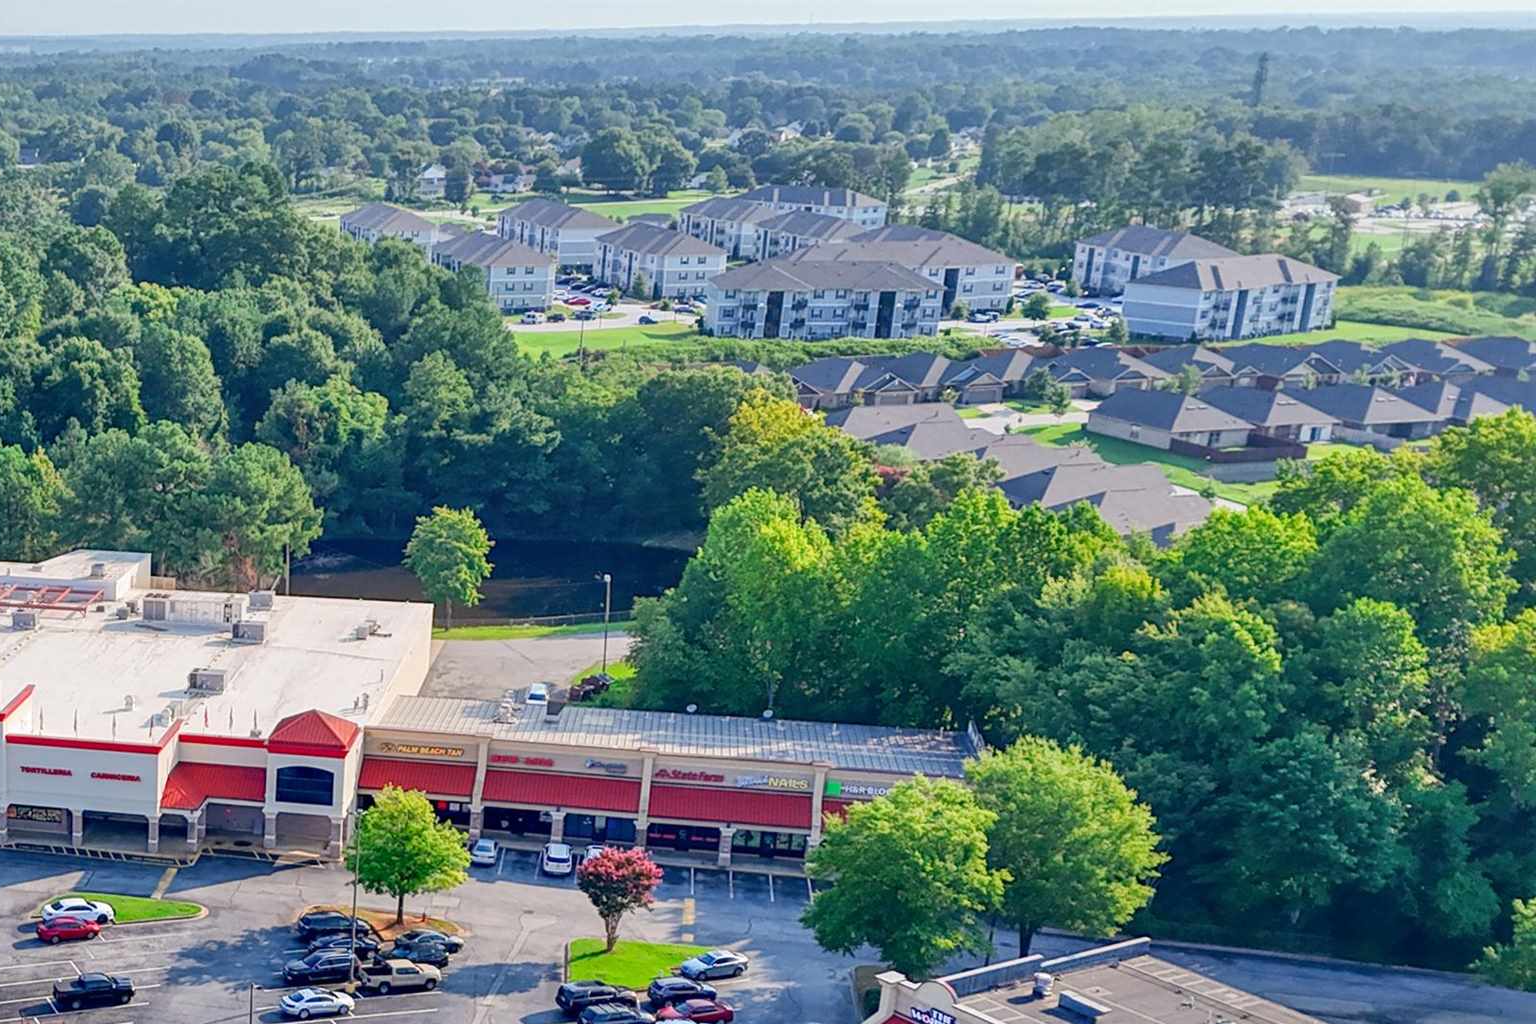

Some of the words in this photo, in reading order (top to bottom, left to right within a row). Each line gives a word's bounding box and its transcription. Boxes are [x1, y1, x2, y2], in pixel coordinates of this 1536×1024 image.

[397, 744, 419, 754] PALM
[419, 746, 446, 756] BEACH
[446, 748, 464, 757] TAN
[20, 766, 72, 777] TORTILLERIA
[933, 1009, 953, 1024] THE
